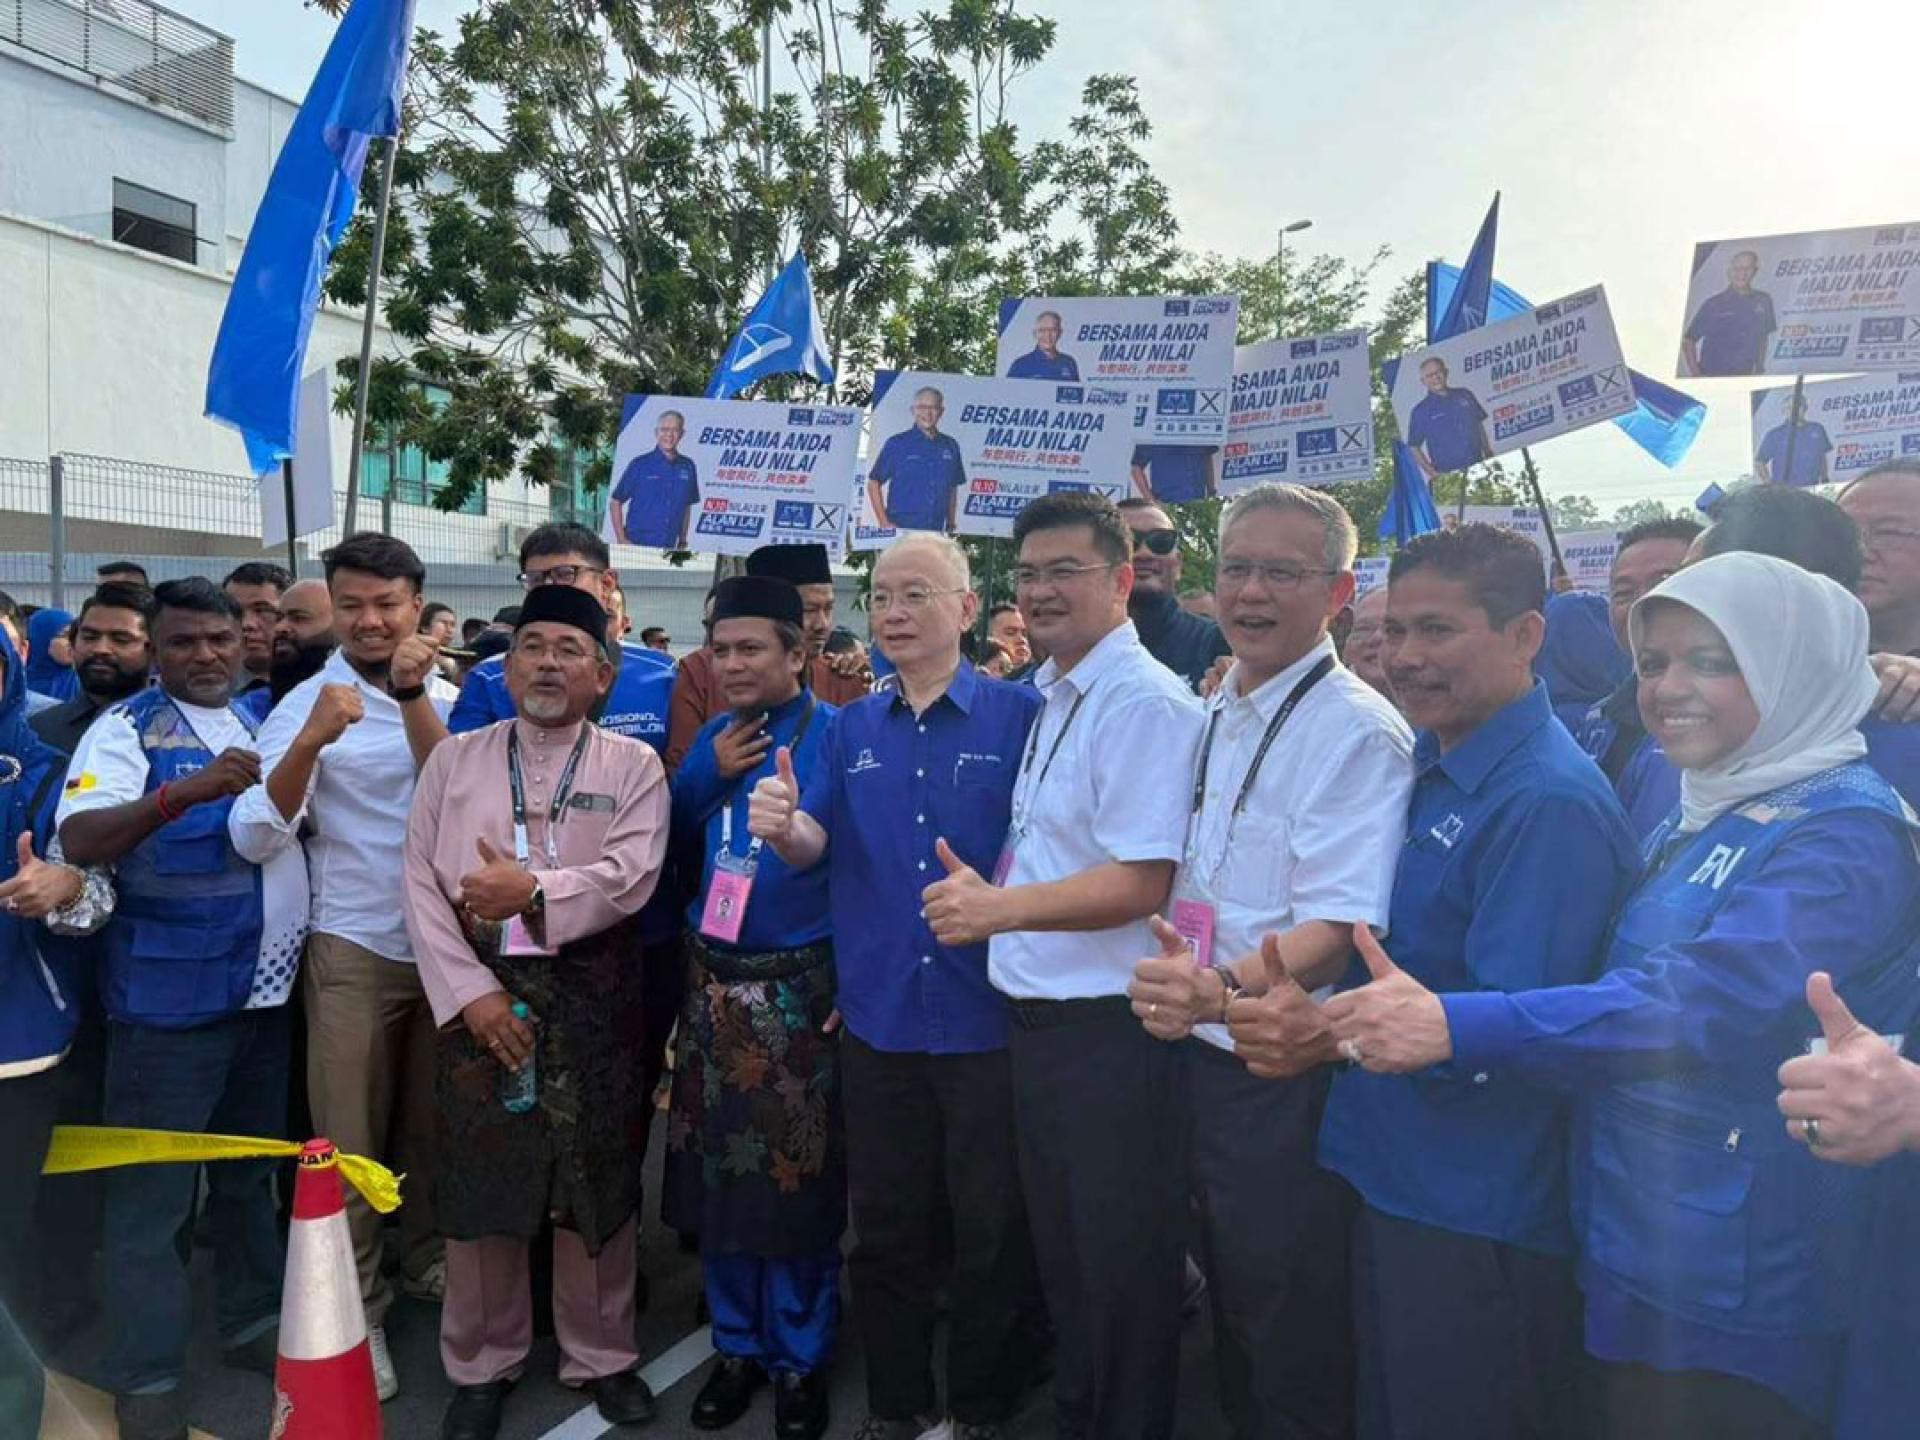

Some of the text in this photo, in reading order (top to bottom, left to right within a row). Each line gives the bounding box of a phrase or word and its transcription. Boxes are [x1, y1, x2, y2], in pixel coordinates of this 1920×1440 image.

[1775, 253, 1867, 278] BERSAMA
[1797, 269, 1909, 294] MAJU NILAI
[1077, 322, 1210, 342] BERSAMA ANDA
[1098, 342, 1197, 361] MAJU NILAI
[1464, 317, 1587, 374] BERSAMA ANDA
[1290, 359, 1340, 385] ANDA
[1490, 354, 1533, 382] MAJU
[1535, 337, 1579, 368] NILAI
[1230, 382, 1328, 413] MAJU NILAI
[1822, 389, 1894, 412] BERSAMA
[960, 404, 1105, 432] BERSAMA ANDA
[1845, 403, 1888, 421] MAJU
[698, 426, 832, 453] BERSAMA ANDA
[984, 427, 1091, 452] MAJU NILAI
[719, 449, 817, 473] MAJU NILAI
